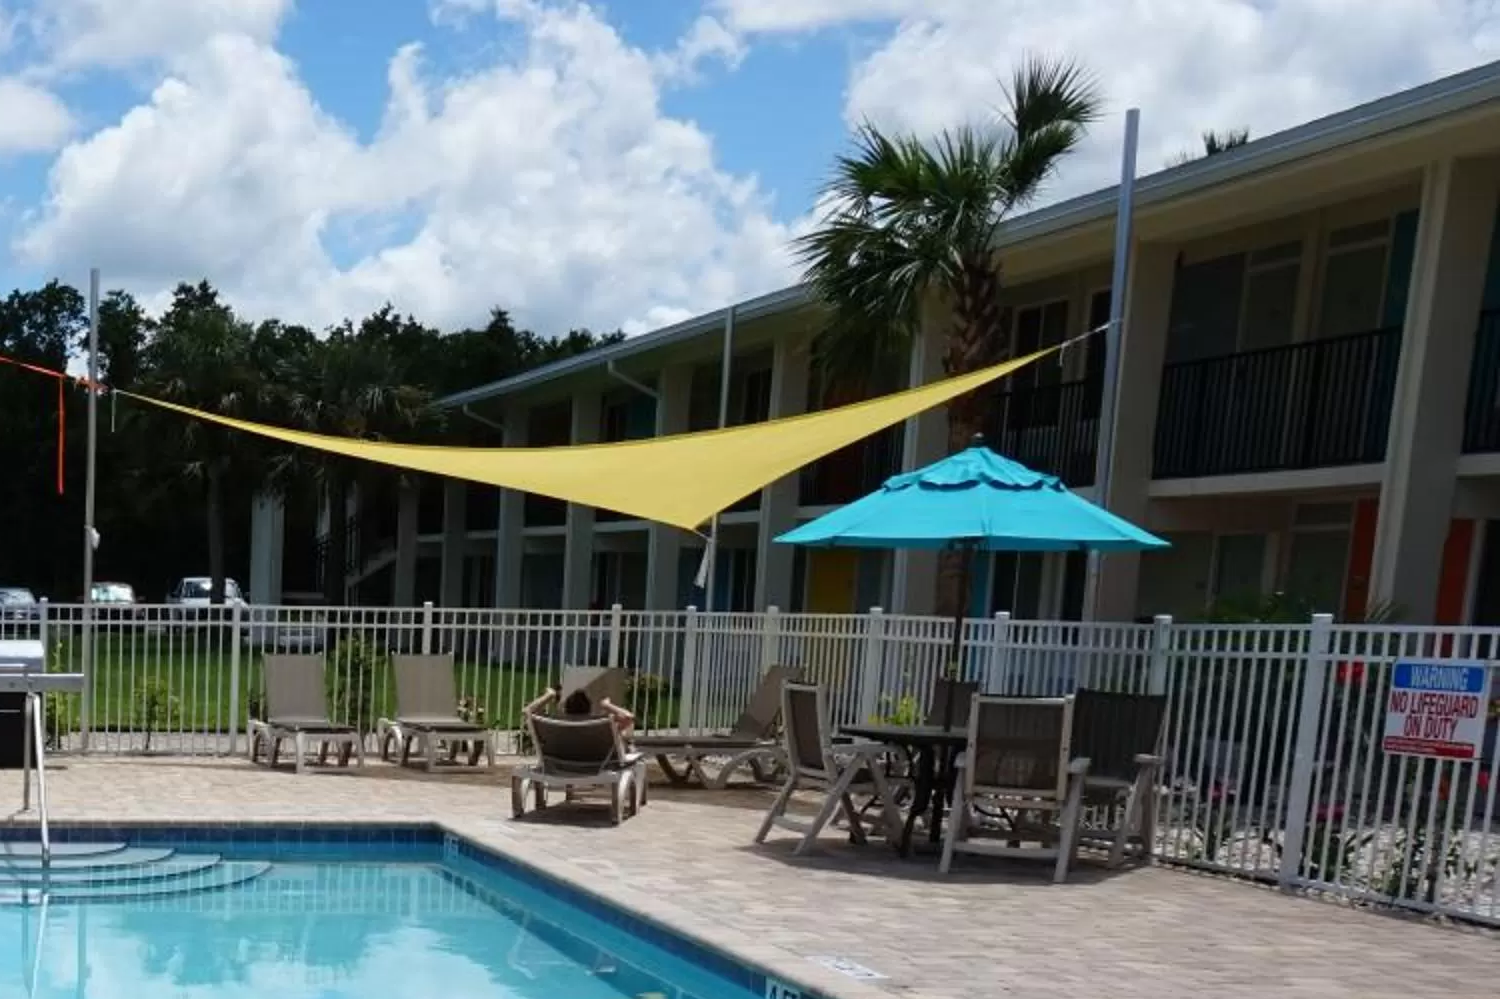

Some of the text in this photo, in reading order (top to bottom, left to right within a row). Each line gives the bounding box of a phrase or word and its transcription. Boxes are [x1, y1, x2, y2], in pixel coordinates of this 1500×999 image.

[1411, 665, 1469, 691] WARNING
[1390, 691, 1479, 718] NO LIFEGUARD
[1404, 715, 1459, 740] ON DUTY
